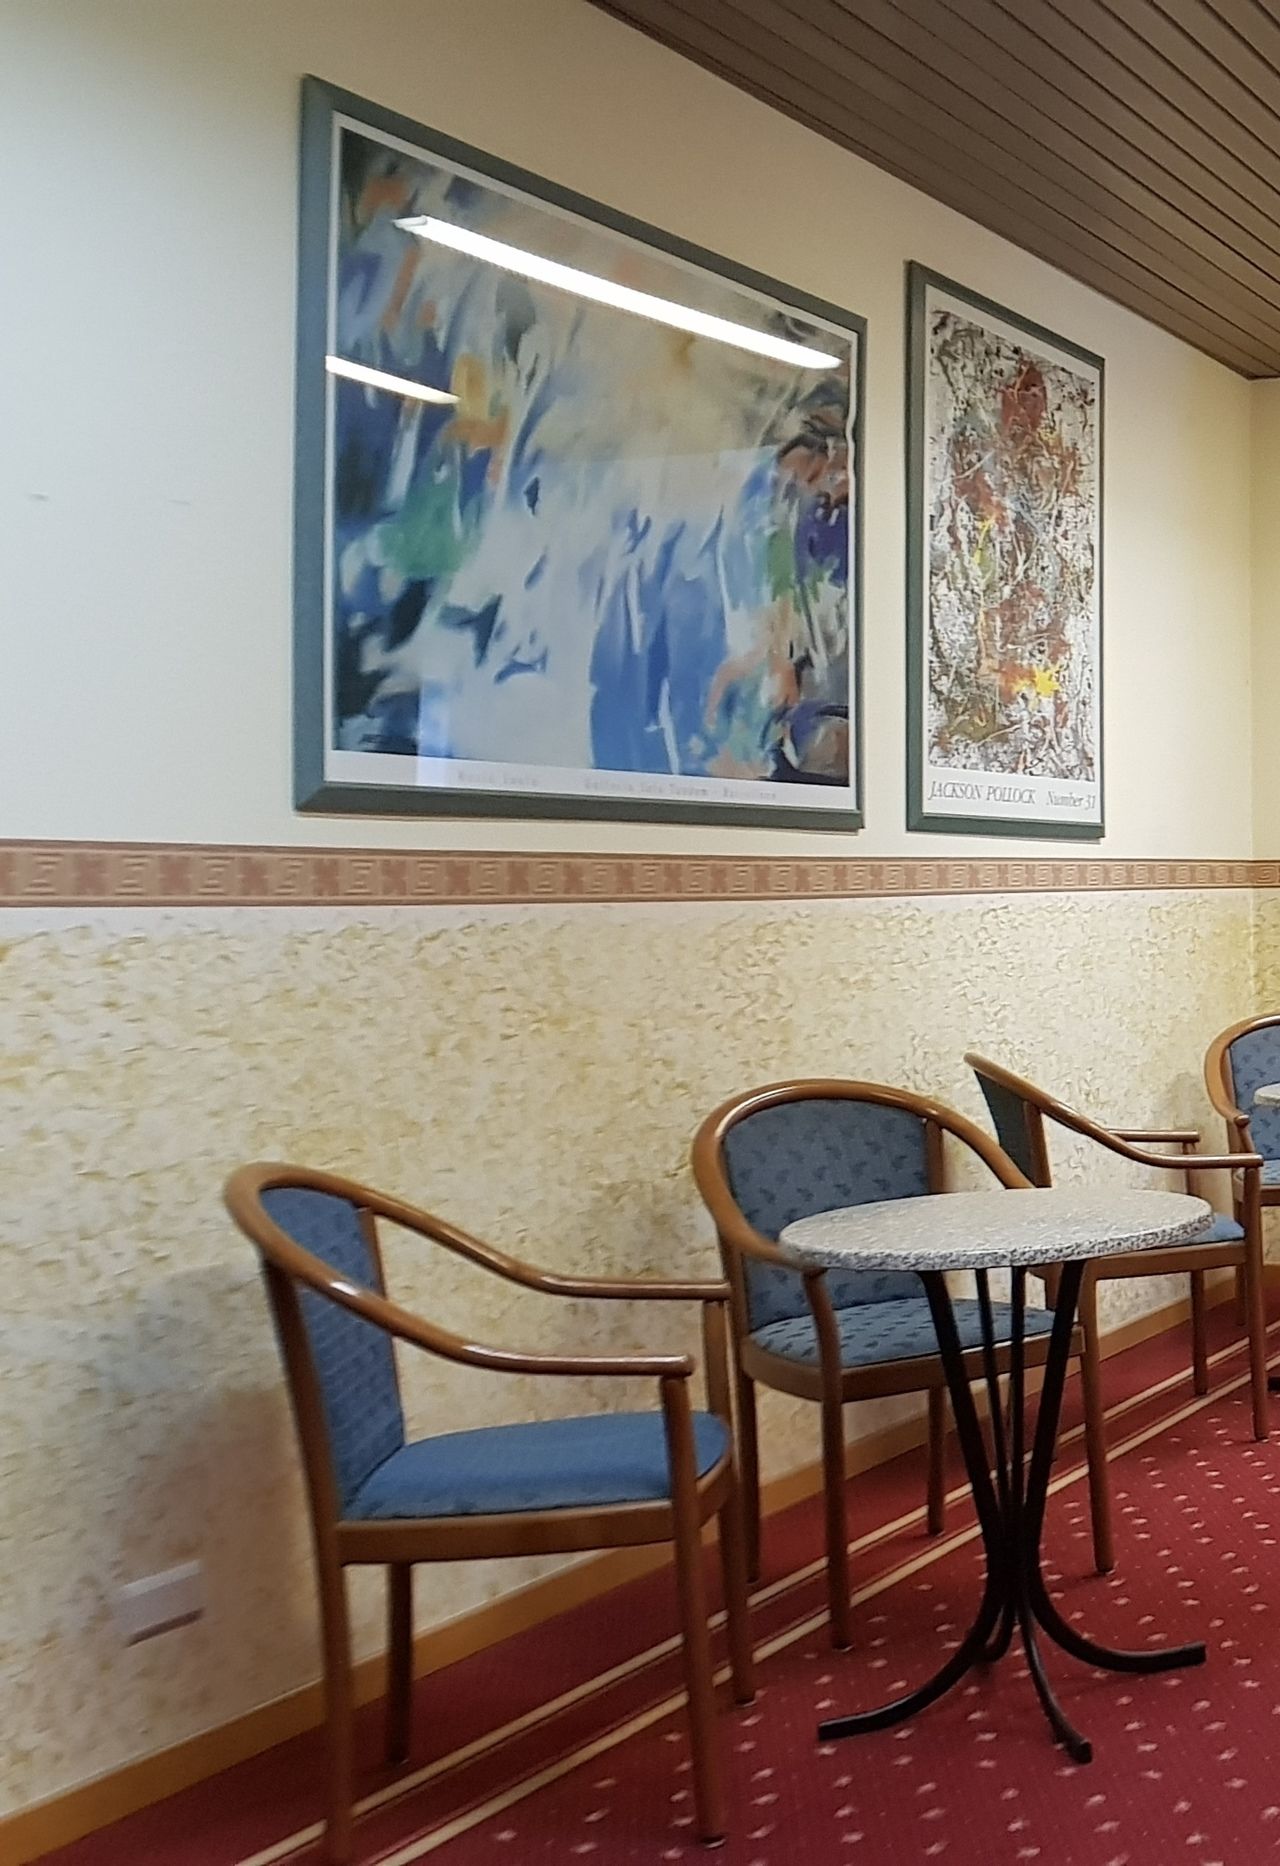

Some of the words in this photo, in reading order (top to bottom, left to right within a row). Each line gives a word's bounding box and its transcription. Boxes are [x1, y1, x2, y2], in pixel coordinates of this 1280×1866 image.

[928, 781, 982, 800] JACKSON
[987, 786, 1036, 804] POLLOCK
[1046, 791, 1084, 808] Number
